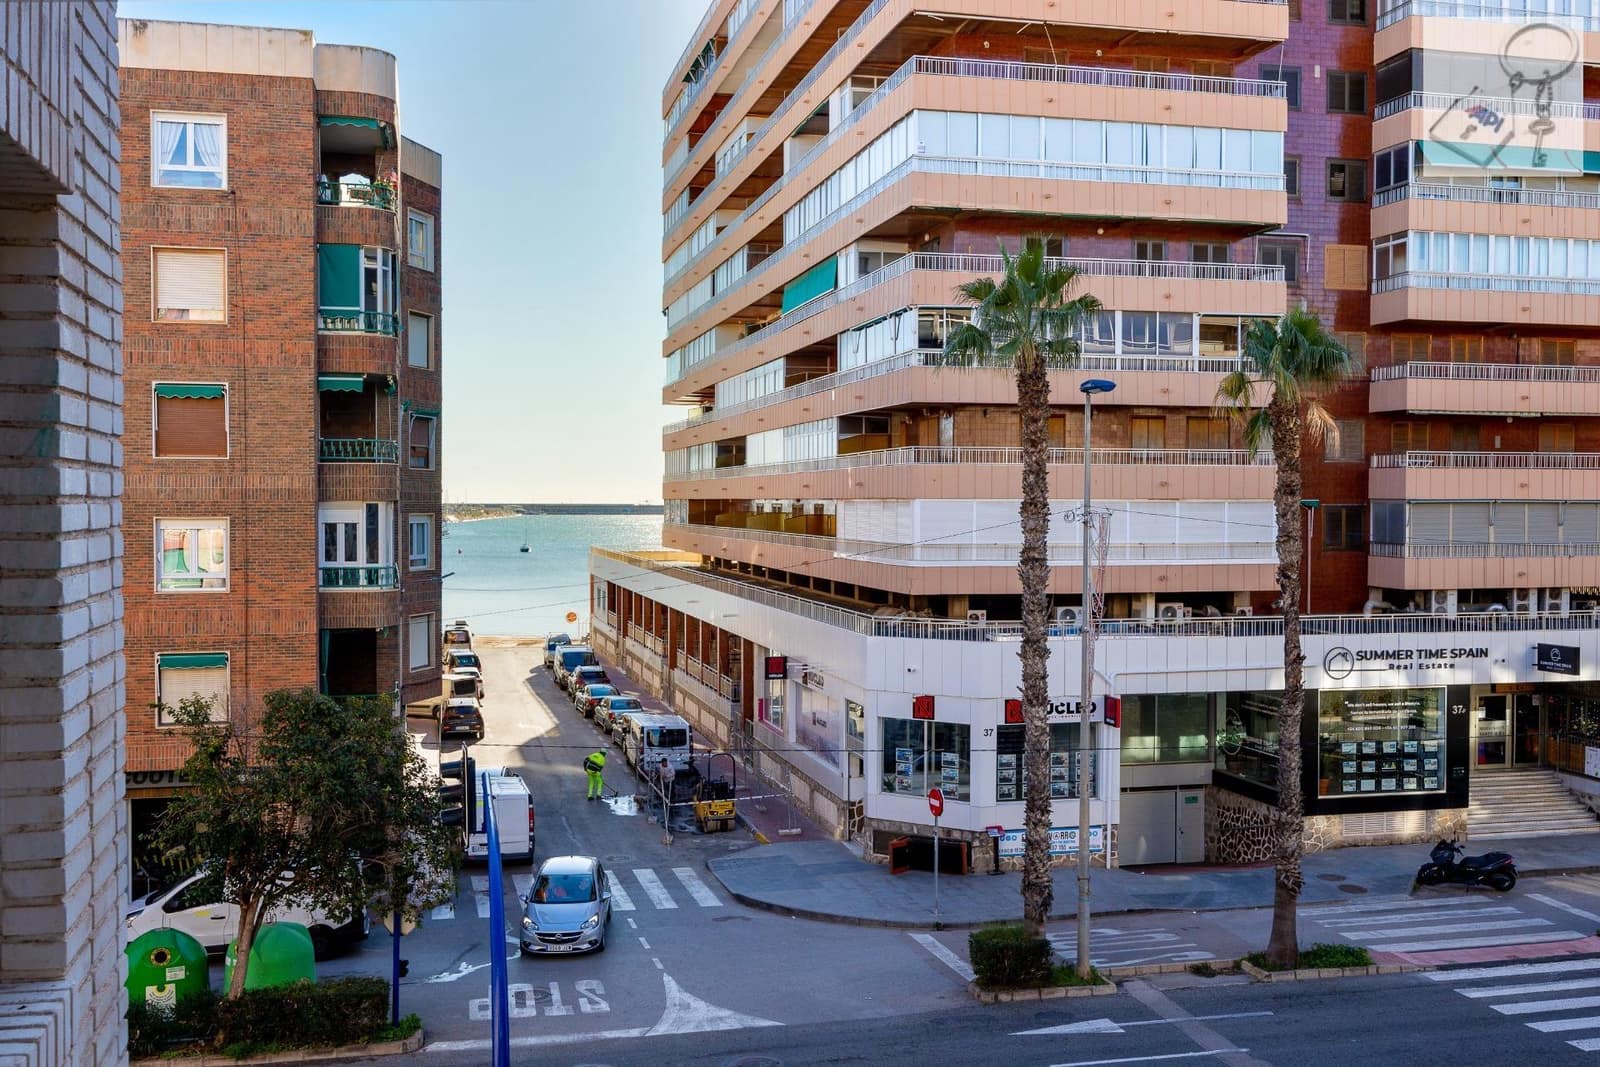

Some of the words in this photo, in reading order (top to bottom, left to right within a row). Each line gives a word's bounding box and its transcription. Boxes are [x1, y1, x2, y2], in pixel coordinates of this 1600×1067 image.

[1356, 649, 1413, 661] SUMMER
[1416, 648, 1448, 660] TIME
[1450, 647, 1488, 659] SPAIN
[1388, 663, 1413, 671] Real
[1419, 662, 1455, 670] Estate
[983, 728, 994, 737] 37
[468, 979, 611, 1021] STOP
